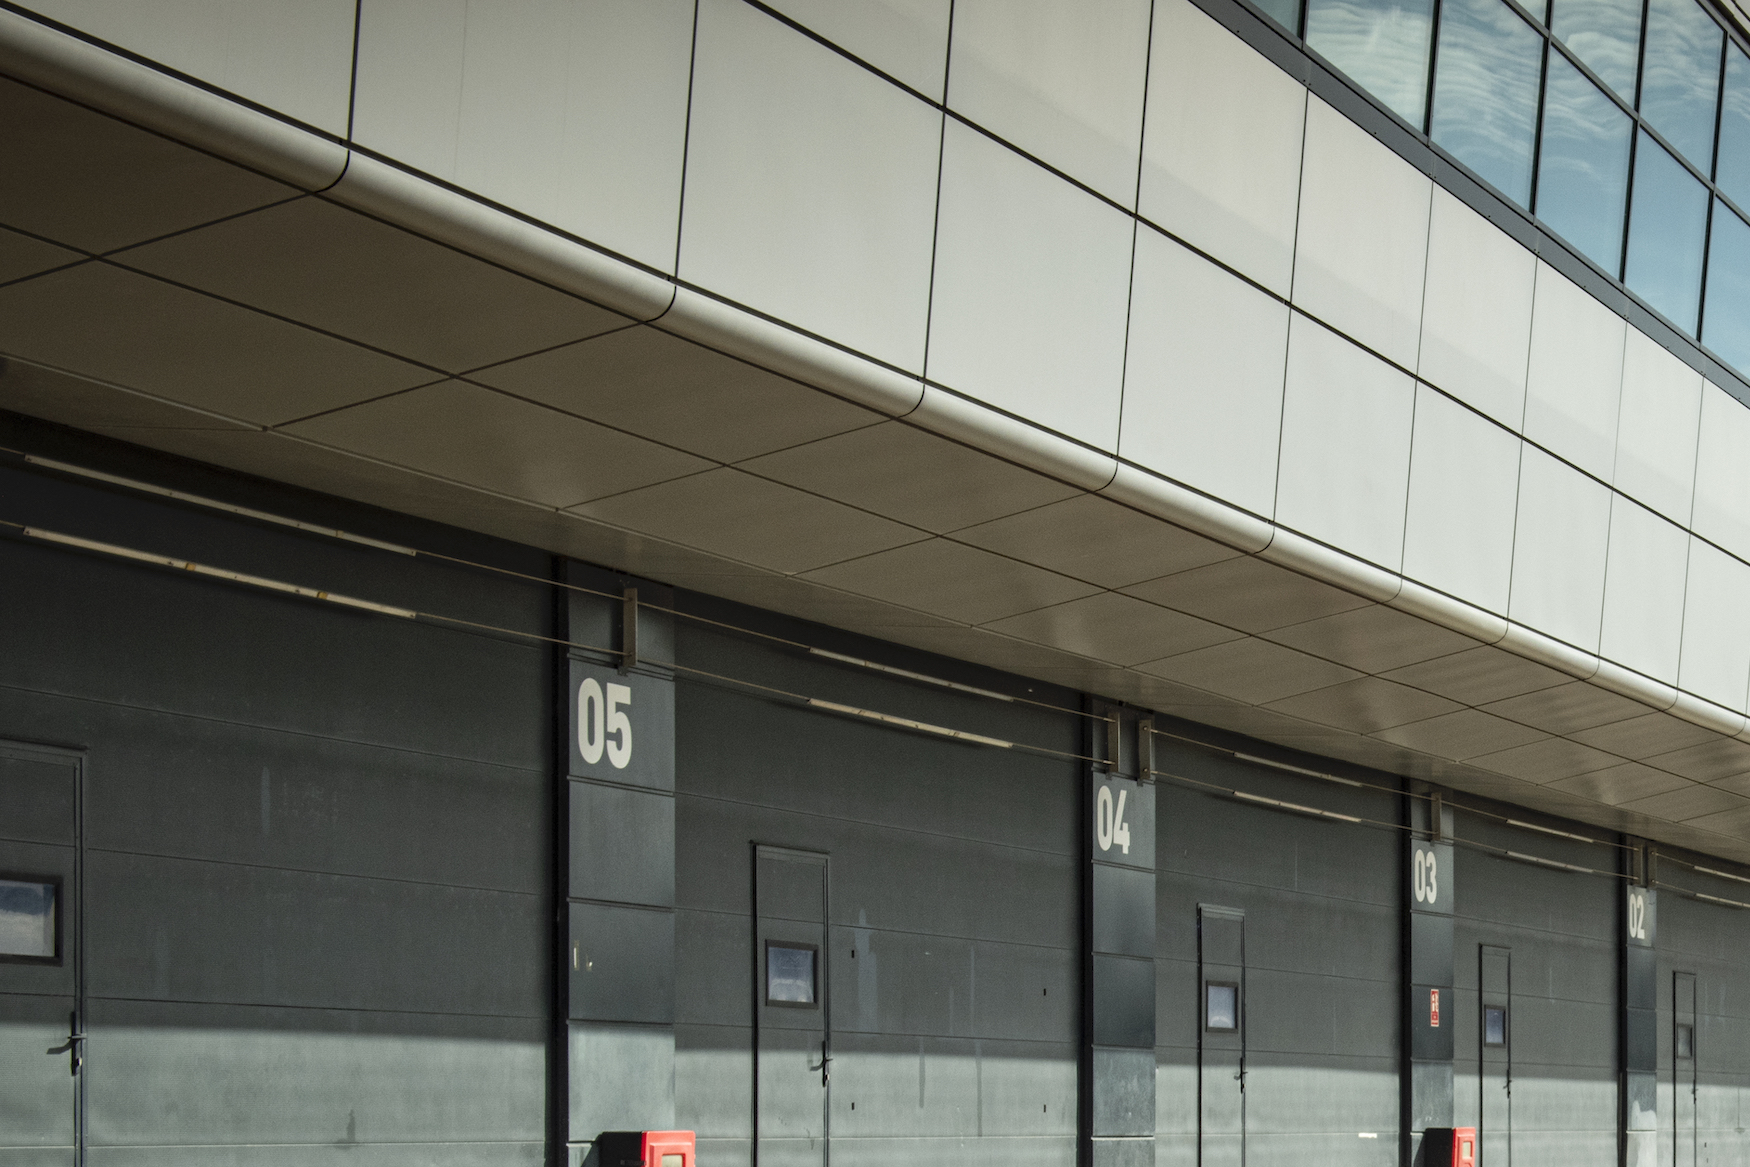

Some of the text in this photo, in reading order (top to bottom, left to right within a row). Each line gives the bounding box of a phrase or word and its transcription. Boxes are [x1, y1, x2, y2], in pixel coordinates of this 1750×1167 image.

[578, 677, 632, 769] 05
[1097, 785, 1130, 854] 04
[1414, 849, 1437, 904] 03
[1629, 893, 1645, 940] 02
